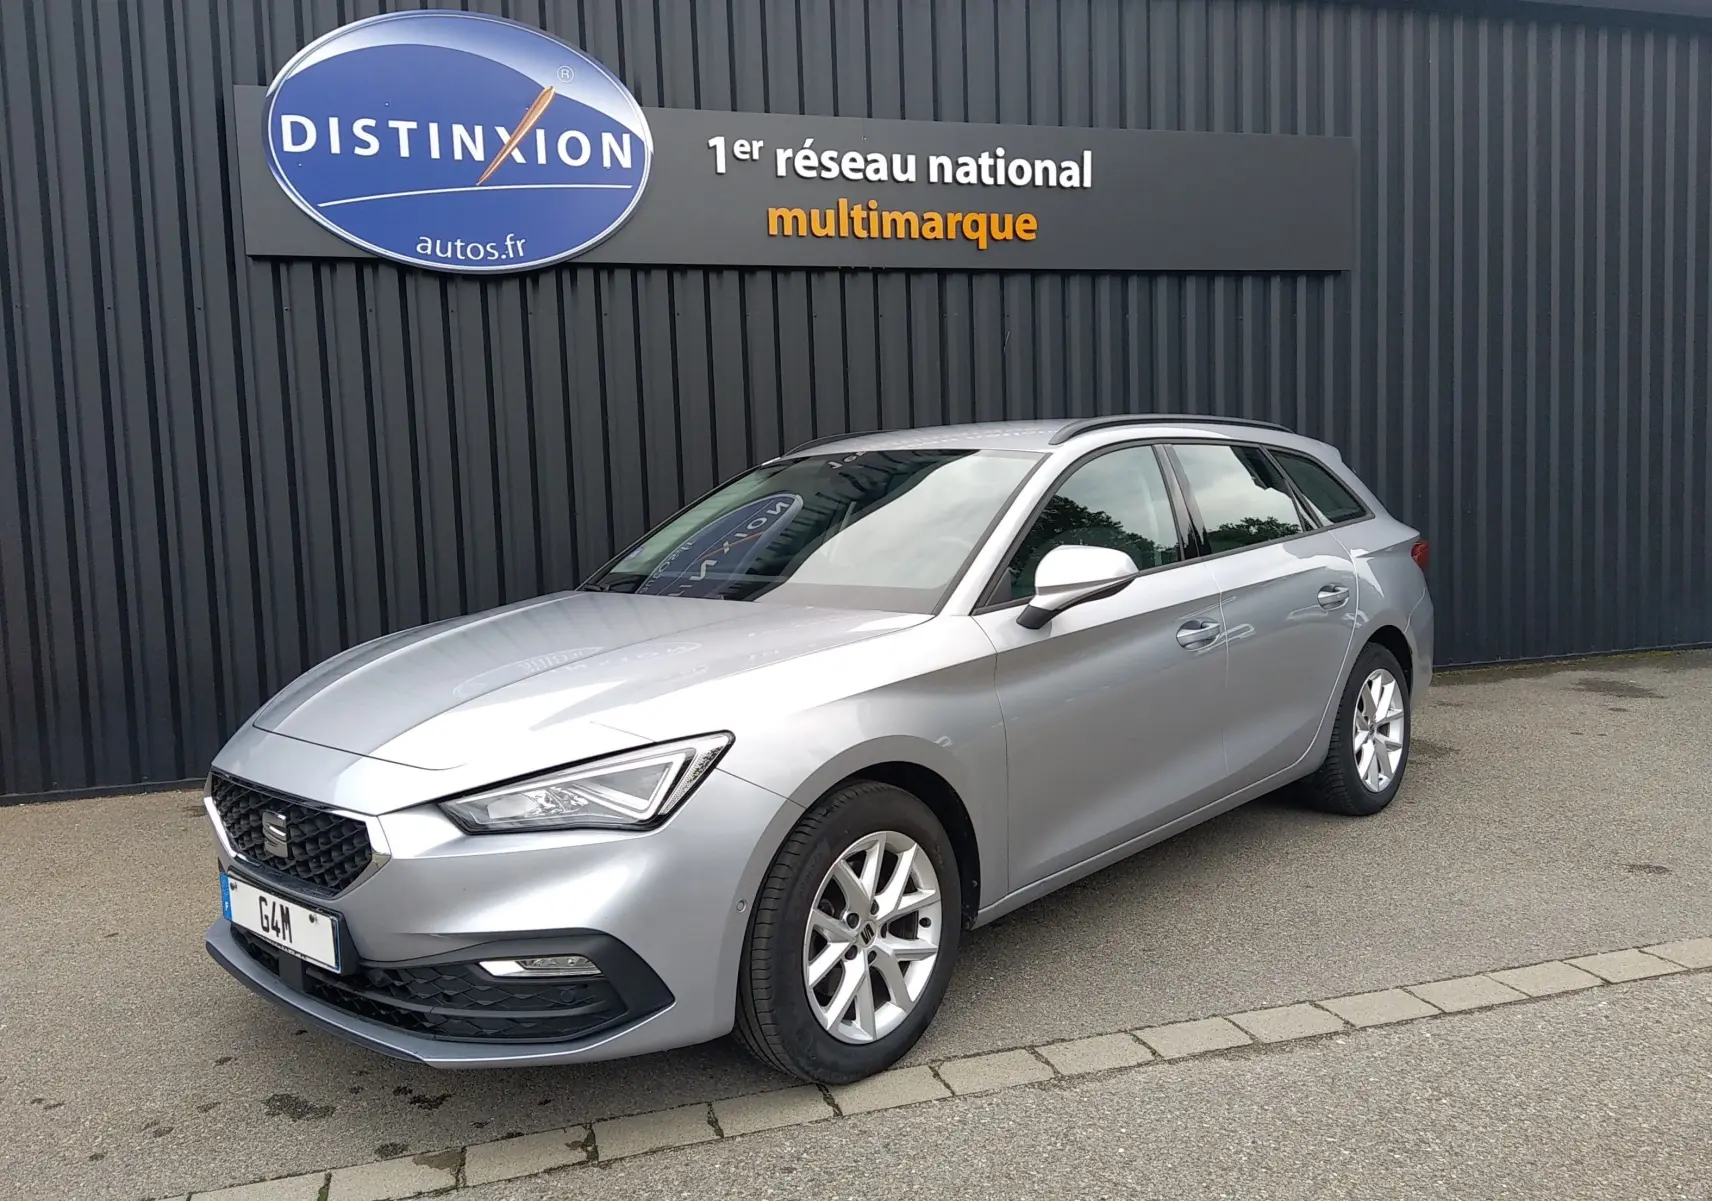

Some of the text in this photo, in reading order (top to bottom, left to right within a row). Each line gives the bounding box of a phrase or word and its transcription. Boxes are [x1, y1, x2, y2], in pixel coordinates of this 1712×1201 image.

[280, 114, 633, 170] DISTINXION
[707, 135, 1093, 188] 1er réseau national
[416, 233, 527, 262] autos.fr
[767, 198, 1039, 250] multimarque
[258, 895, 293, 944] G4M
